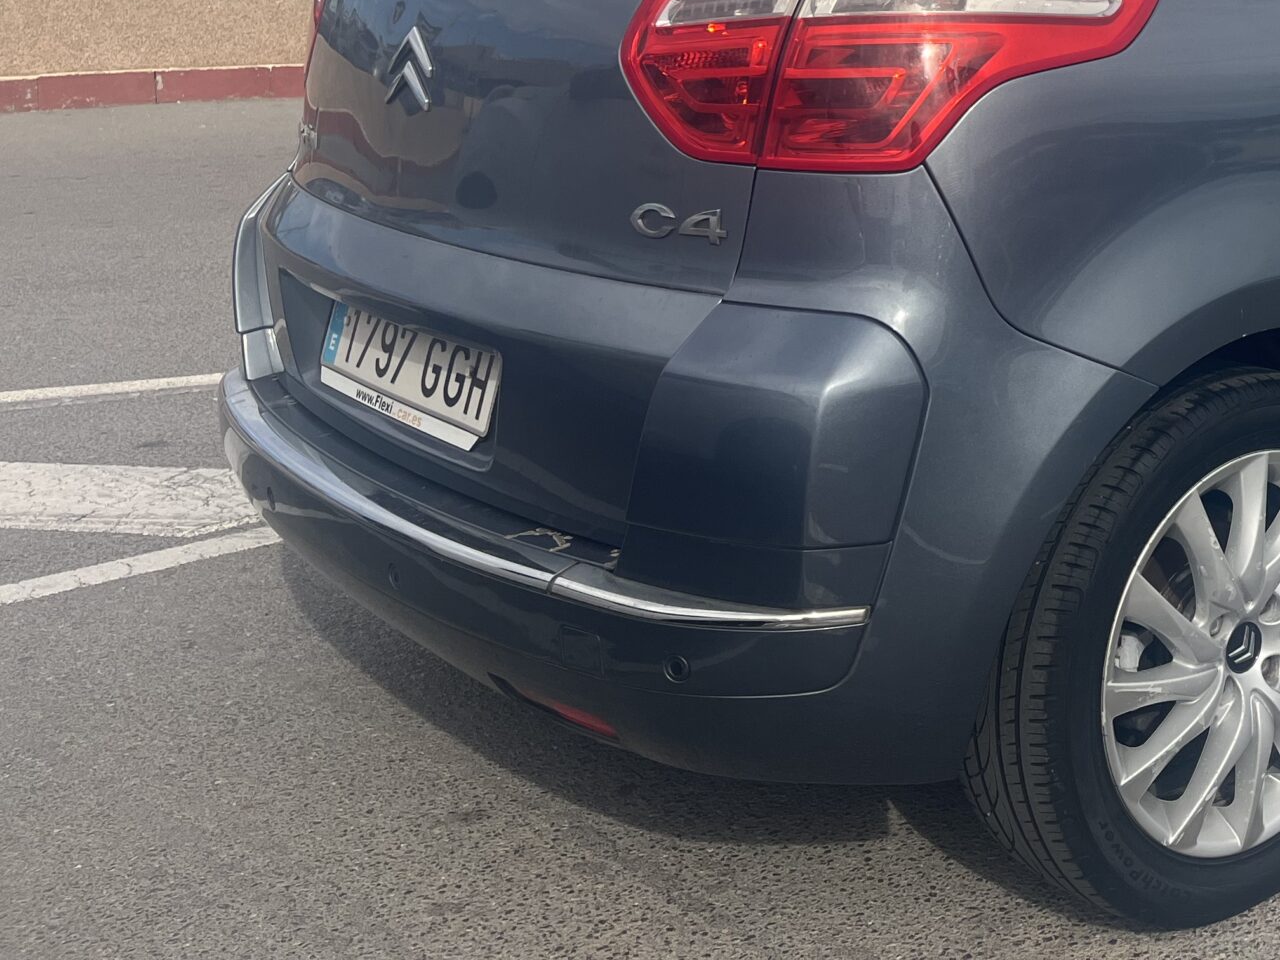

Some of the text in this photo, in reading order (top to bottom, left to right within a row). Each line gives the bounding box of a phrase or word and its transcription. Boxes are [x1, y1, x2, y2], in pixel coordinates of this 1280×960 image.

[630, 202, 729, 246] C4
[344, 309, 496, 421] 1797 GGH
